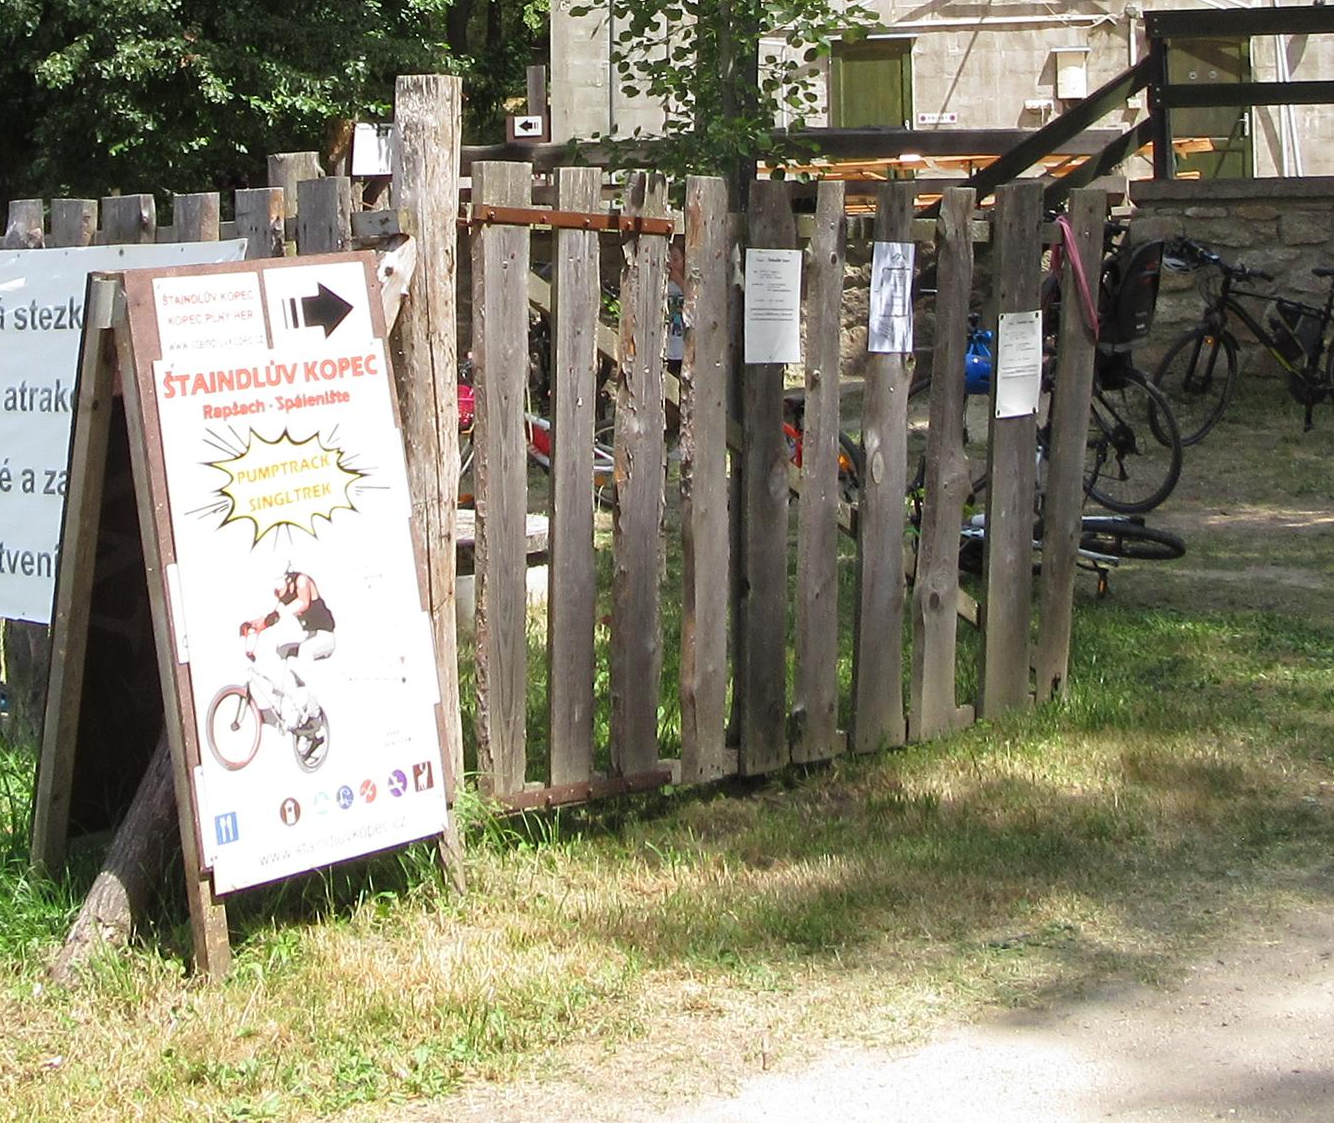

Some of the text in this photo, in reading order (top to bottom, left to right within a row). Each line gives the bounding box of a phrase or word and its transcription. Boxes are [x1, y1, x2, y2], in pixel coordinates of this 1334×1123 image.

[220, 289, 254, 302] KOPEC
[168, 313, 202, 325] KOPEC
[234, 309, 253, 320] HER
[163, 354, 378, 398] ŠTAINDLŮV KOPEC
[203, 399, 265, 421] Rapšach
[21, 468, 35, 494] a
[237, 454, 331, 484] PUMPTRACK
[249, 482, 332, 512] SINGLTREK
